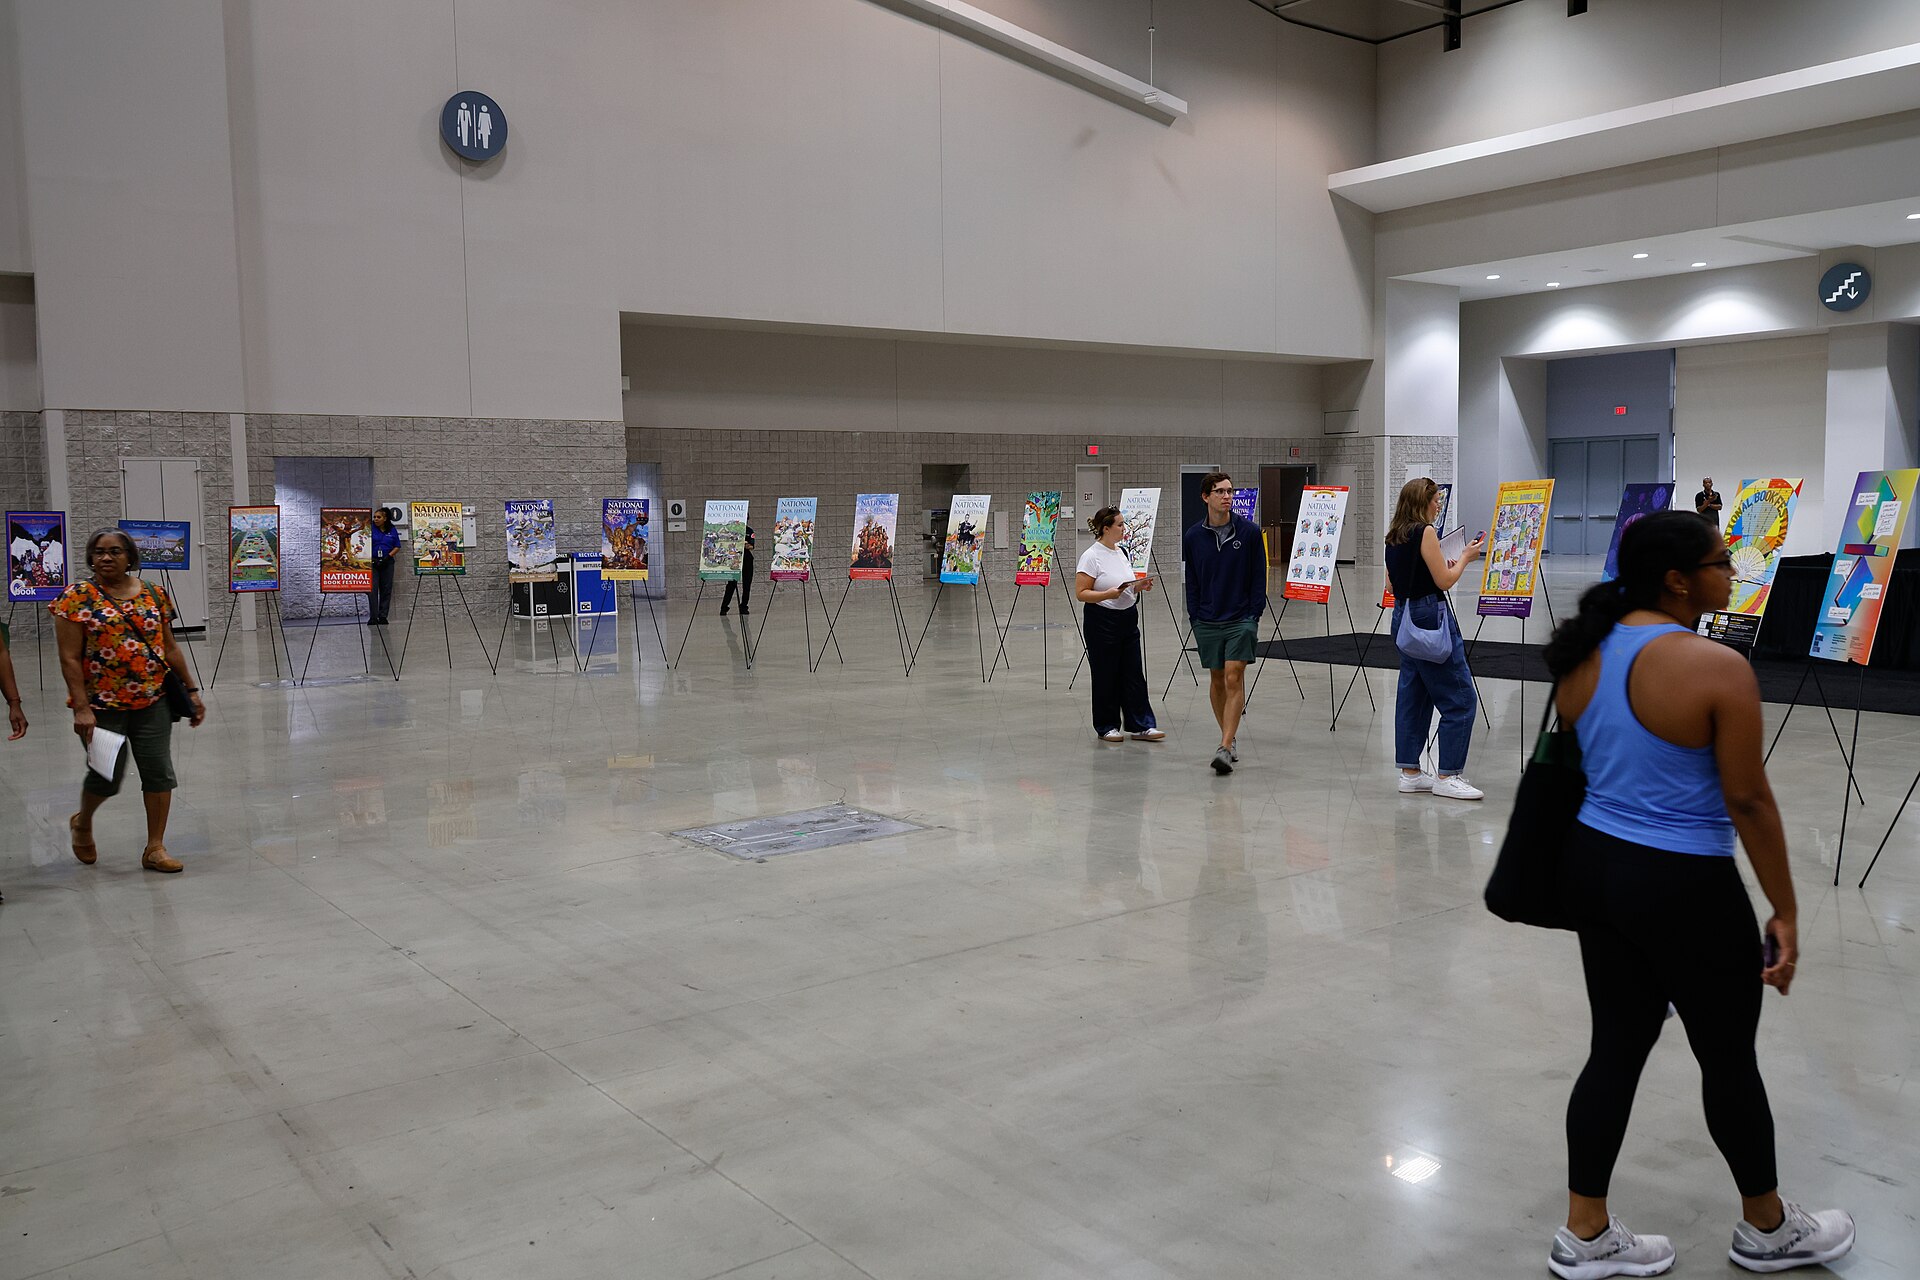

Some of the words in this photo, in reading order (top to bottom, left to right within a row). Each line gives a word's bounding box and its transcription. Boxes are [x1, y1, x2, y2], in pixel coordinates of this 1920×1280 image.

[1754, 490, 1778, 503] BOOK
[414, 505, 460, 513] NATIONAL
[608, 501, 644, 509] NATIONAL
[1308, 502, 1337, 511] NATIONAL
